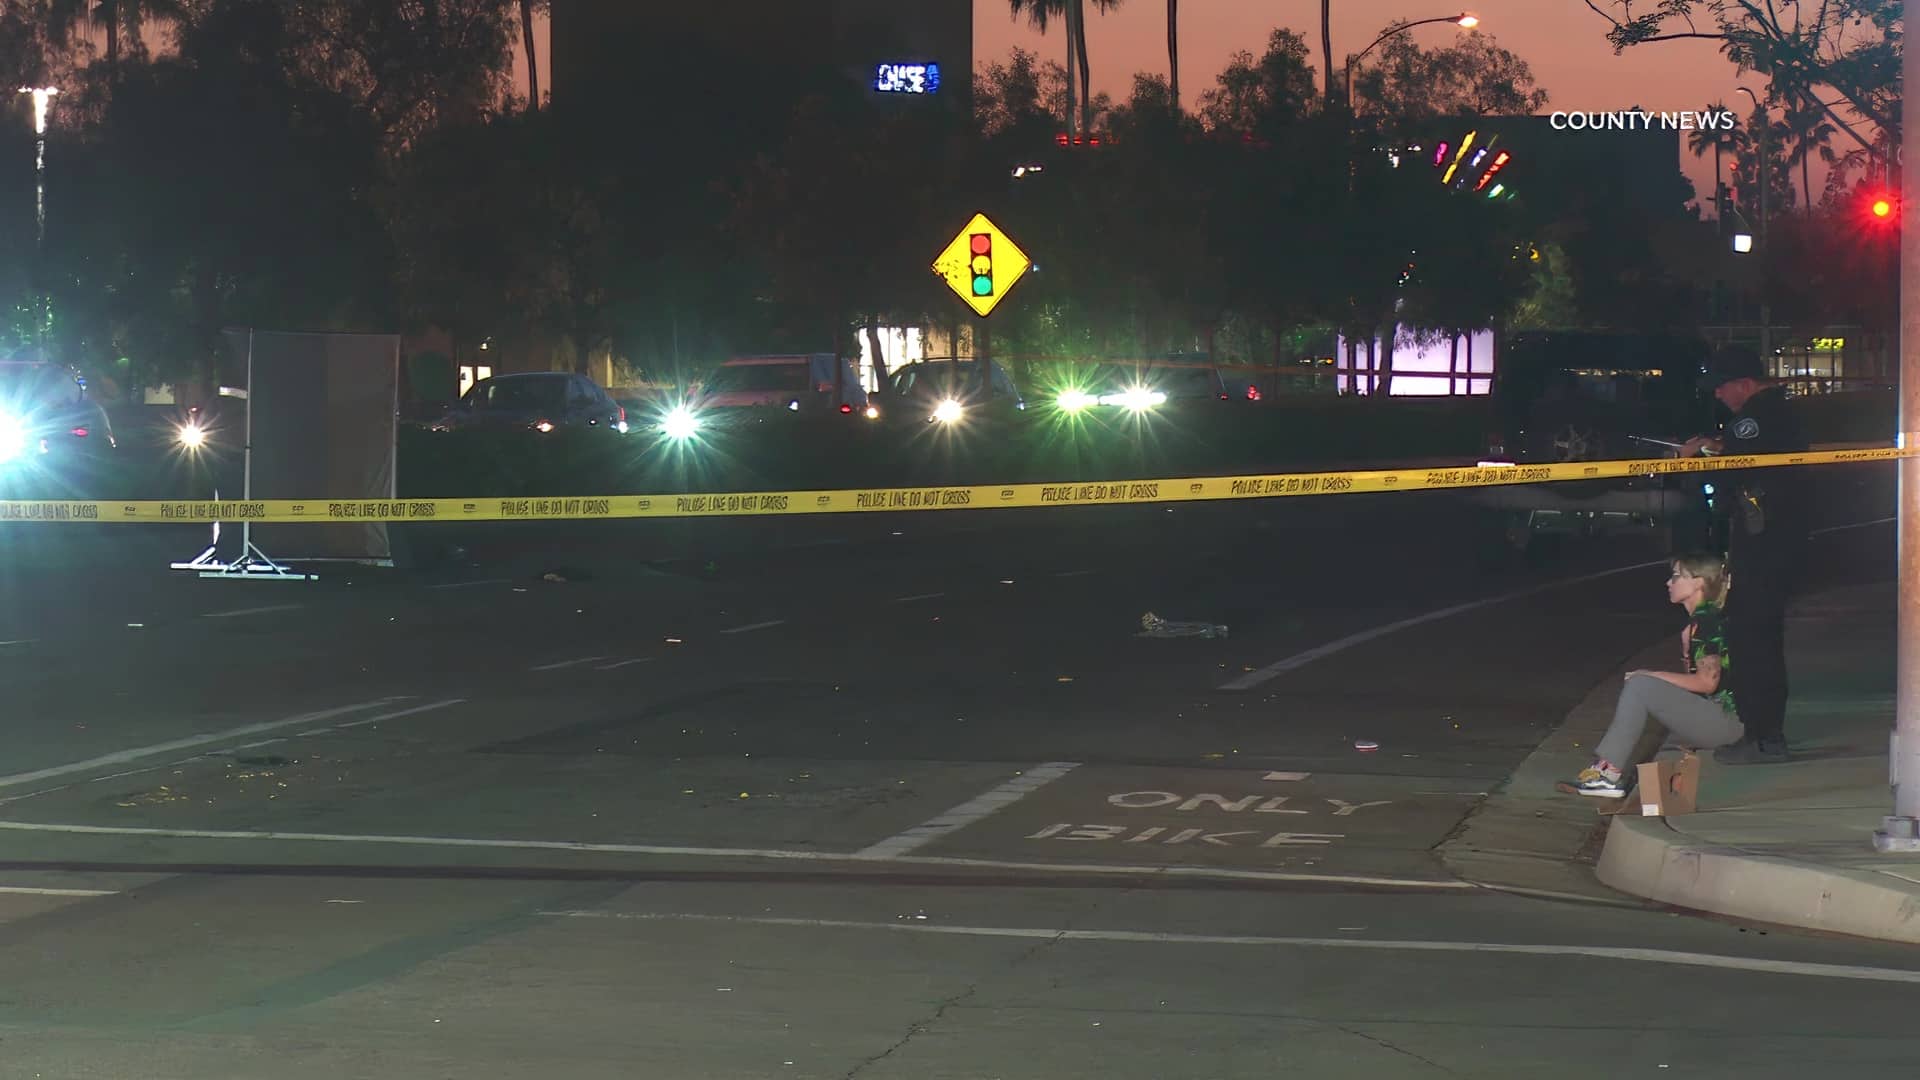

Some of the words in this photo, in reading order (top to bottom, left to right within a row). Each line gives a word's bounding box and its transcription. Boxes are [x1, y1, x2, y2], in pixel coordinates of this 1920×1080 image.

[1703, 459, 1721, 470] NOT
[1461, 471, 1482, 483] LINE
[1500, 469, 1517, 481] NOT
[1041, 487, 1072, 502] POLICE
[1075, 486, 1093, 500] LINE
[1095, 485, 1107, 500] DO
[1109, 484, 1128, 499] NOT
[1130, 483, 1158, 498] CROSS
[1231, 479, 1262, 494] POLICE
[1265, 479, 1285, 493] LINE
[1287, 478, 1299, 492] DO
[1302, 478, 1319, 490] NOT
[1322, 477, 1352, 489] CROSS
[501, 501, 529, 516] POLICE
[532, 501, 548, 515] LINE
[551, 500, 562, 515] DO
[564, 500, 580, 514] NOT
[583, 499, 609, 514] CROSS
[676, 497, 705, 512] POLICE
[708, 497, 725, 511] LINE
[728, 497, 739, 511] DO
[741, 496, 757, 510] NOT
[760, 495, 788, 510] CROSS
[857, 493, 886, 508] POLICE
[889, 492, 907, 507] LINE
[909, 491, 921, 507] DO
[923, 491, 939, 505] NOT
[942, 490, 971, 504] CROSS
[239, 503, 264, 518] CROSS
[329, 503, 356, 517] POLICE
[359, 503, 375, 517] LINE
[378, 503, 388, 517] DO
[391, 503, 405, 517] NOT
[409, 502, 435, 517] CROSS
[1108, 791, 1392, 815] ONLY
[1024, 823, 1344, 848] BIKE
